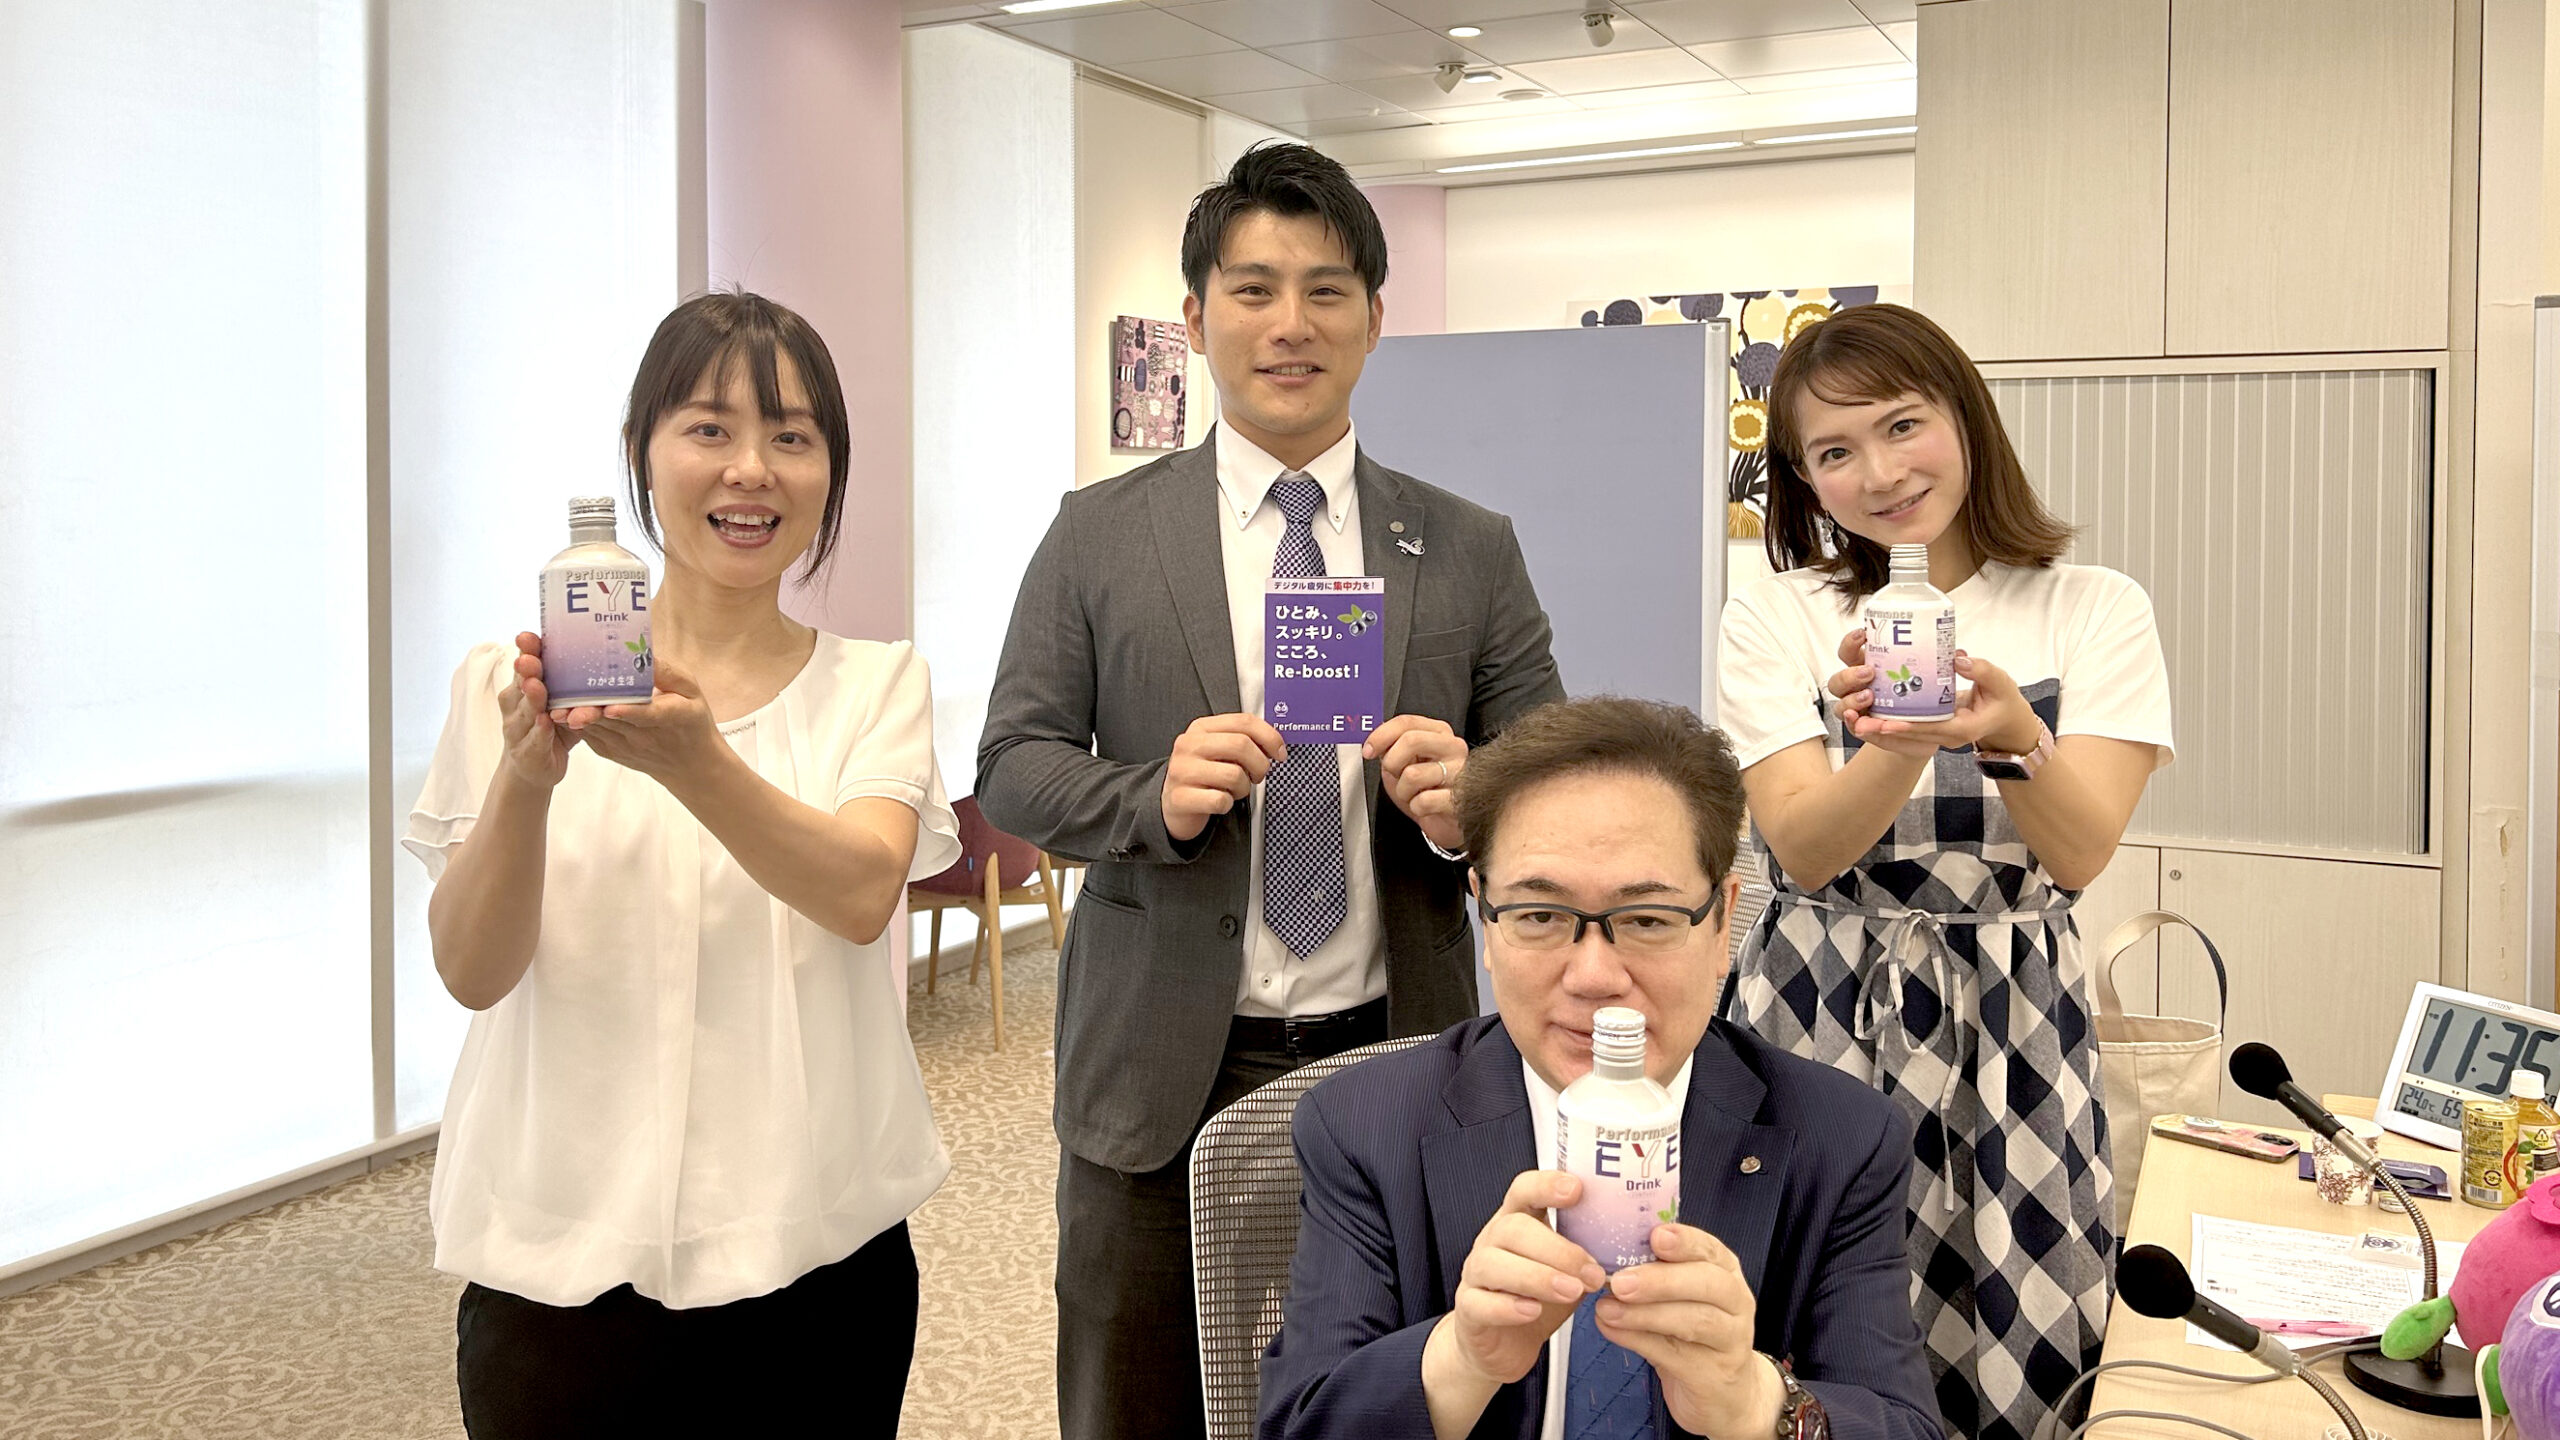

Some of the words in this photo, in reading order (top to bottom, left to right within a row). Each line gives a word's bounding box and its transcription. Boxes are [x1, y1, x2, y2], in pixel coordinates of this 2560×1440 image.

[566, 581, 647, 613] EYE
[594, 612, 629, 622] Drink
[1275, 604, 1328, 620] ひとみ、
[1275, 625, 1343, 640] スッキリ。
[1865, 617, 1912, 646] YE
[1275, 645, 1328, 659] こころ、
[1274, 664, 1360, 678] Re-boost!
[586, 675, 635, 687] わかさ生活
[1273, 722, 1331, 731] Performance
[1332, 715, 1374, 731] EYE
[2422, 1008, 2560, 1095] 11:35
[1595, 1132, 1679, 1179] EYE
[1626, 1178, 1662, 1191] Drink
